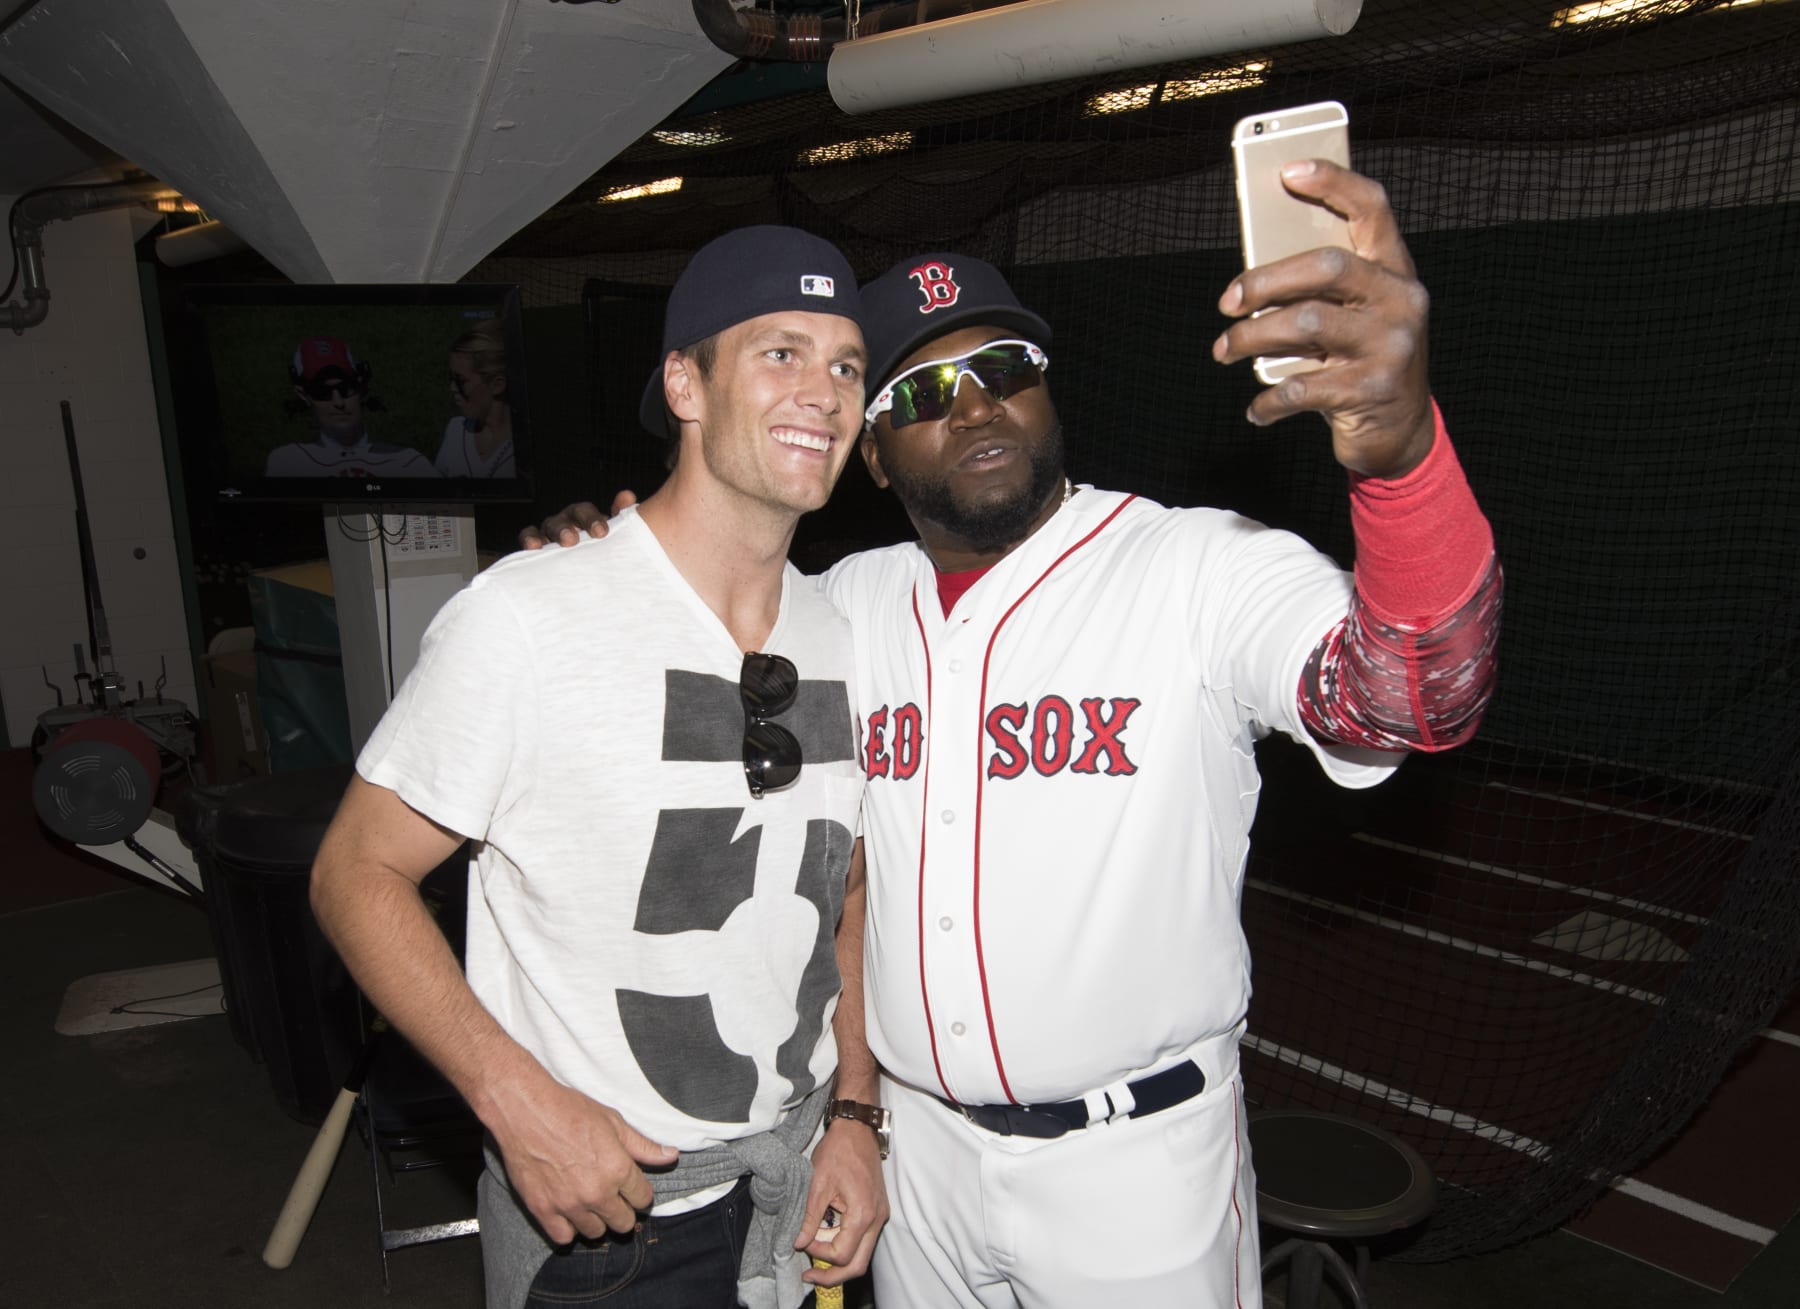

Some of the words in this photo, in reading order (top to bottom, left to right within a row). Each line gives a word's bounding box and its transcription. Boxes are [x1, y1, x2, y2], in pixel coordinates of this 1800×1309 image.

[908, 260, 961, 314] B
[857, 702, 923, 781] ED
[985, 694, 1142, 781] SOX
